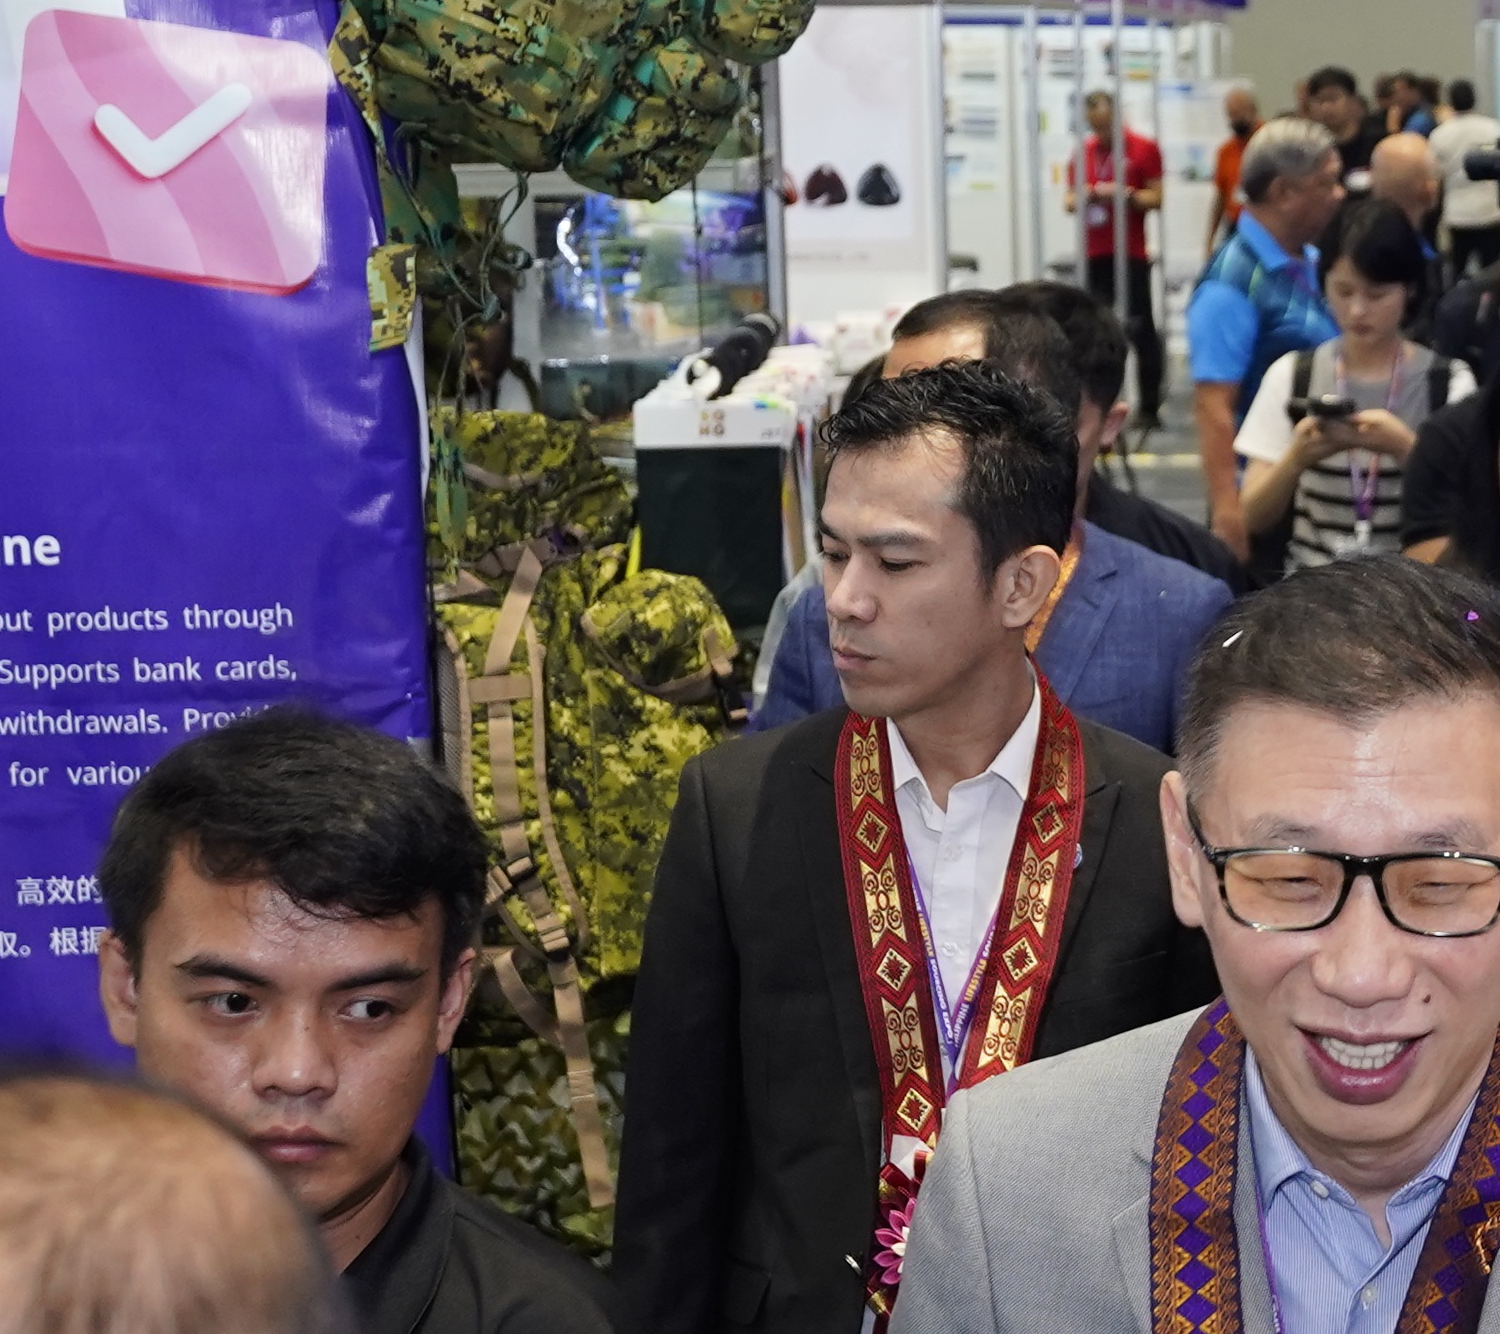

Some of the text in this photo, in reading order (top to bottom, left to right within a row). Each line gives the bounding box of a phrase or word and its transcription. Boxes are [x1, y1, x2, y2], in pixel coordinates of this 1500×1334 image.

[47, 605, 169, 637] products
[183, 602, 294, 635] through
[133, 656, 202, 683] bank
[215, 654, 297, 682] cards,
[10, 762, 49, 787] for
[67, 761, 150, 786] vario
